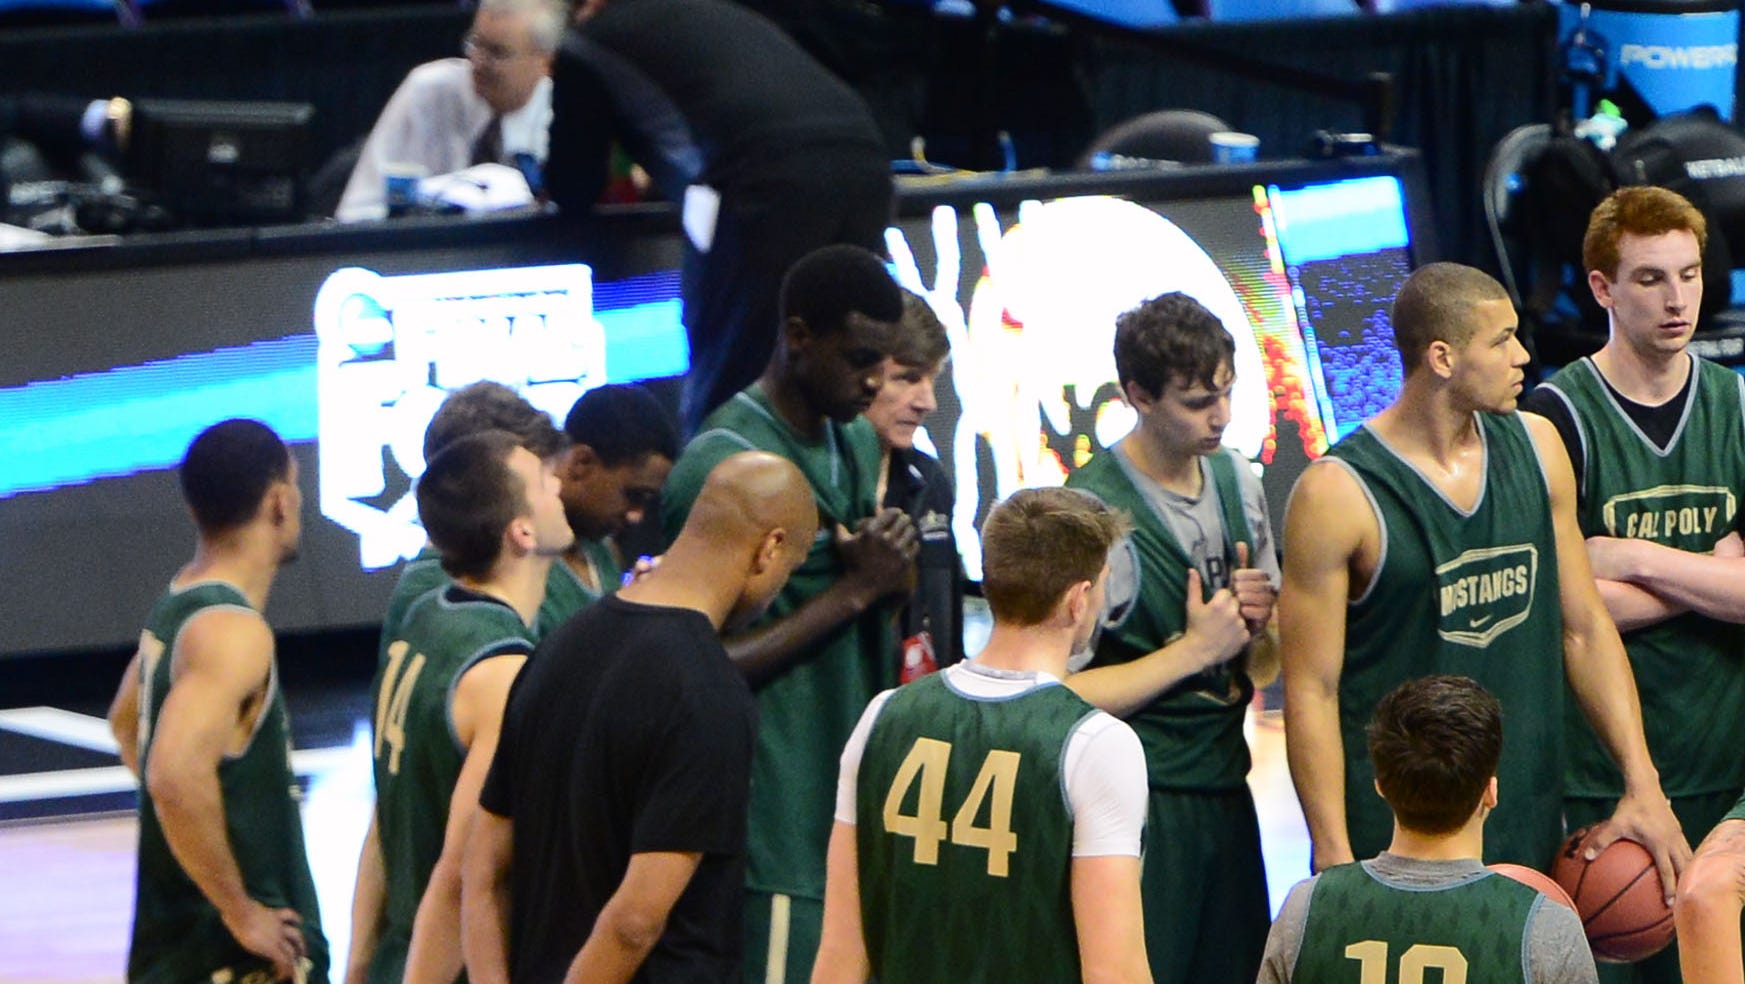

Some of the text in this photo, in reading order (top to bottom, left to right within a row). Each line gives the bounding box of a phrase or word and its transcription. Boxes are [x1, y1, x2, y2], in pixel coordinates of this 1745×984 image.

[1664, 506, 1718, 538] POLY
[374, 639, 426, 775] 14
[883, 736, 1021, 877] 44
